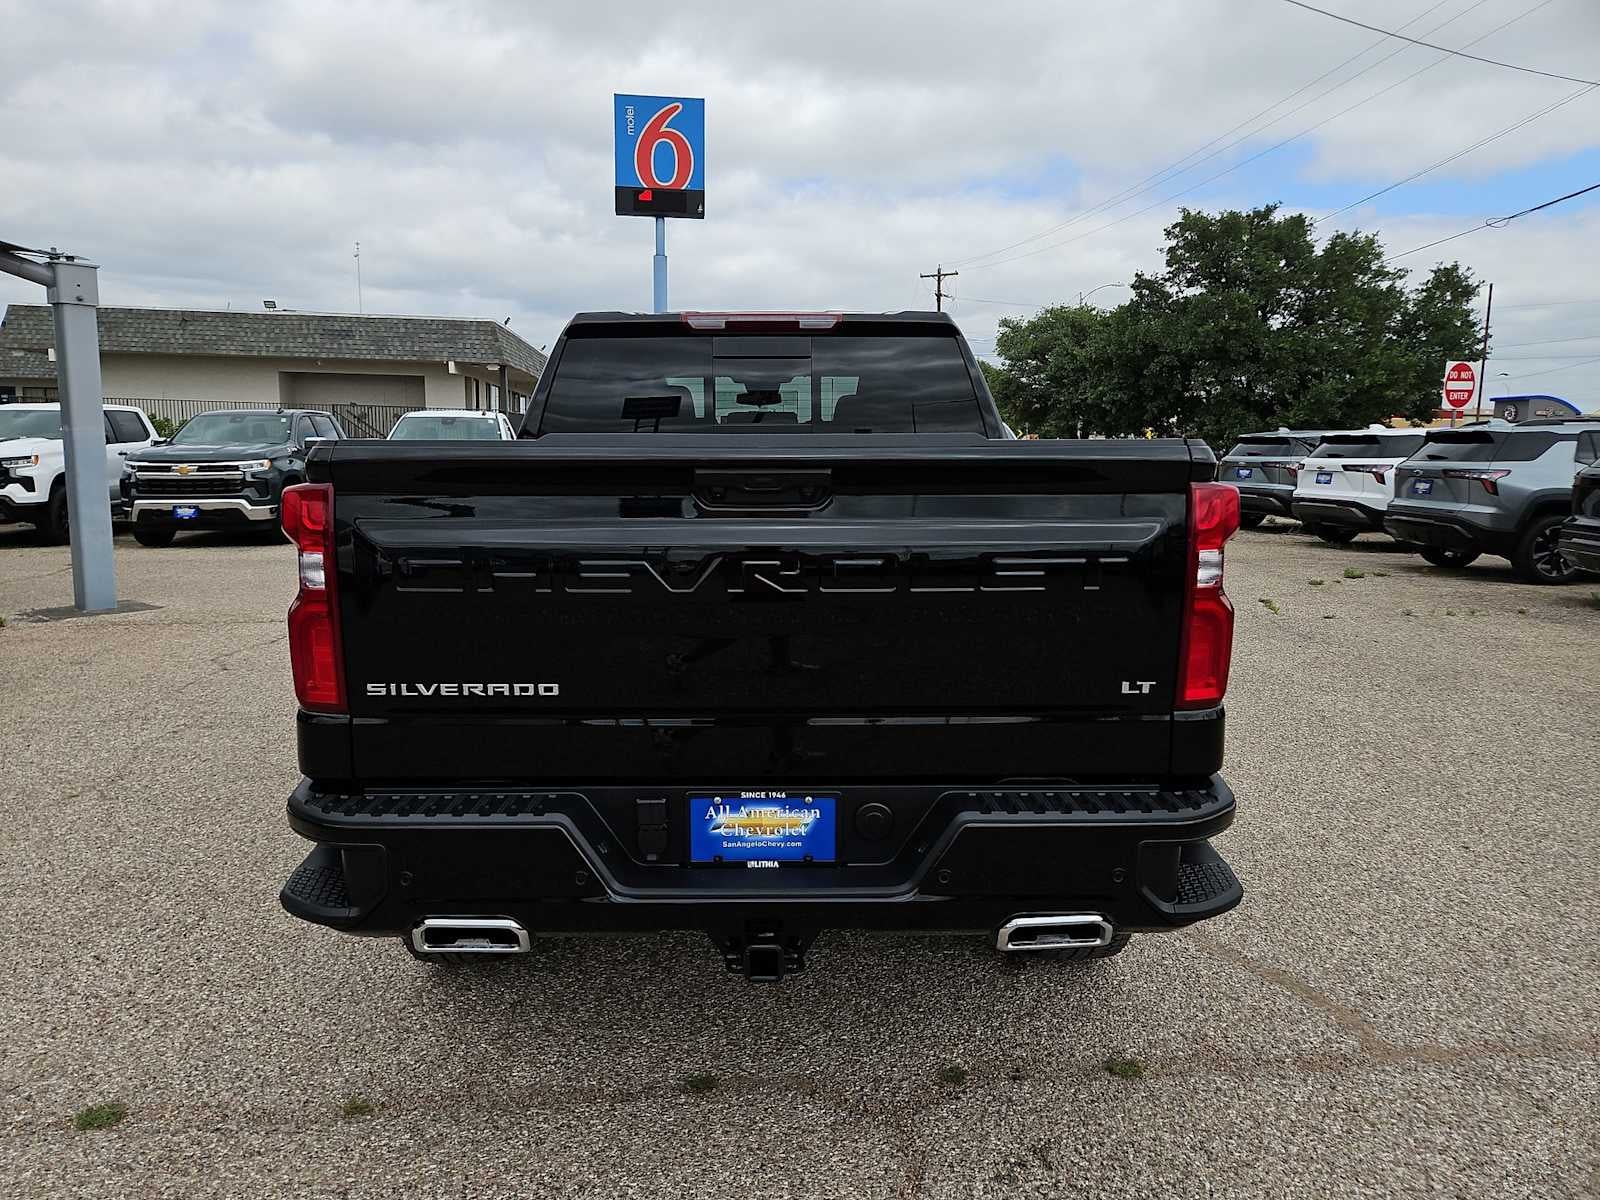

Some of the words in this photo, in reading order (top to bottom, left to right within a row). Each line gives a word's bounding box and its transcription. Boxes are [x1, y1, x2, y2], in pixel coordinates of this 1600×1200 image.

[625, 106, 634, 135] motel
[634, 102, 694, 189] 6
[1449, 371, 1458, 379] DO
[1460, 371, 1472, 379] NOT
[1449, 391, 1469, 400] ENTER
[366, 683, 560, 696] SILVERADO
[1121, 681, 1156, 694] LT
[740, 791, 766, 799] SINCE
[768, 791, 786, 799] 1946
[704, 805, 730, 819] All
[738, 805, 821, 819] American
[720, 822, 807, 837] Chevrolet
[722, 840, 802, 848] SanAngeloChevy.com
